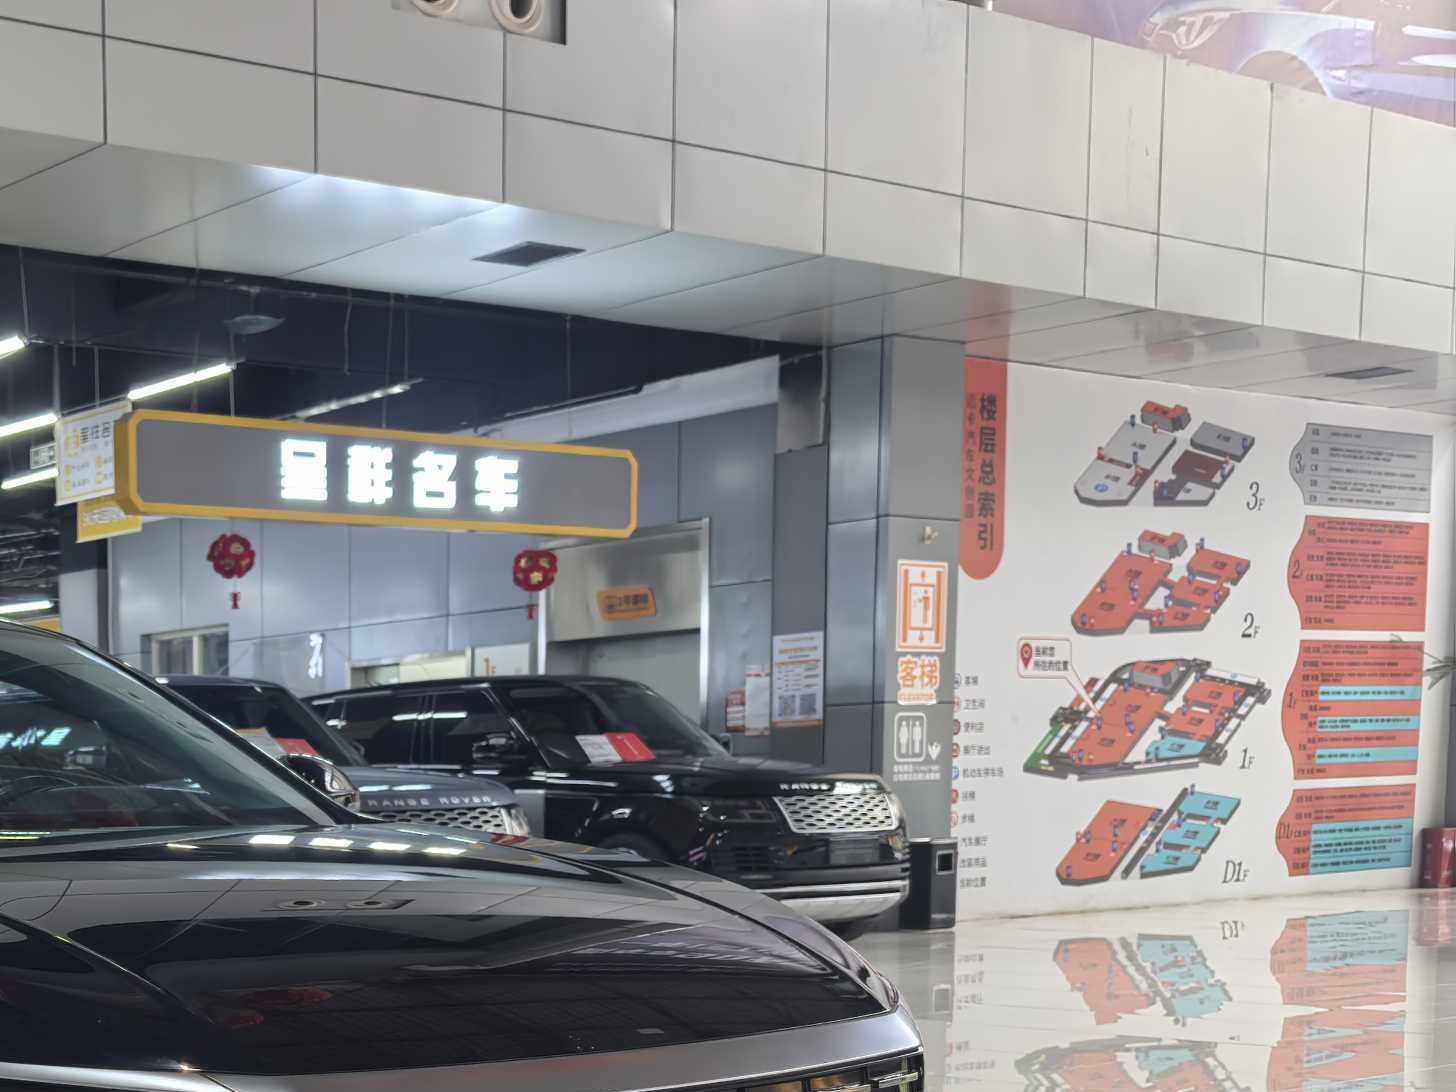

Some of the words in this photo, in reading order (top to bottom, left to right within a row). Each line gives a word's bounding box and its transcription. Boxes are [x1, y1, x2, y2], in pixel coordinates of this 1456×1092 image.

[977, 393, 997, 552] 楼层总索引
[899, 657, 939, 689] 客梯
[367, 797, 431, 808] RANGE
[438, 795, 493, 805] ROVER
